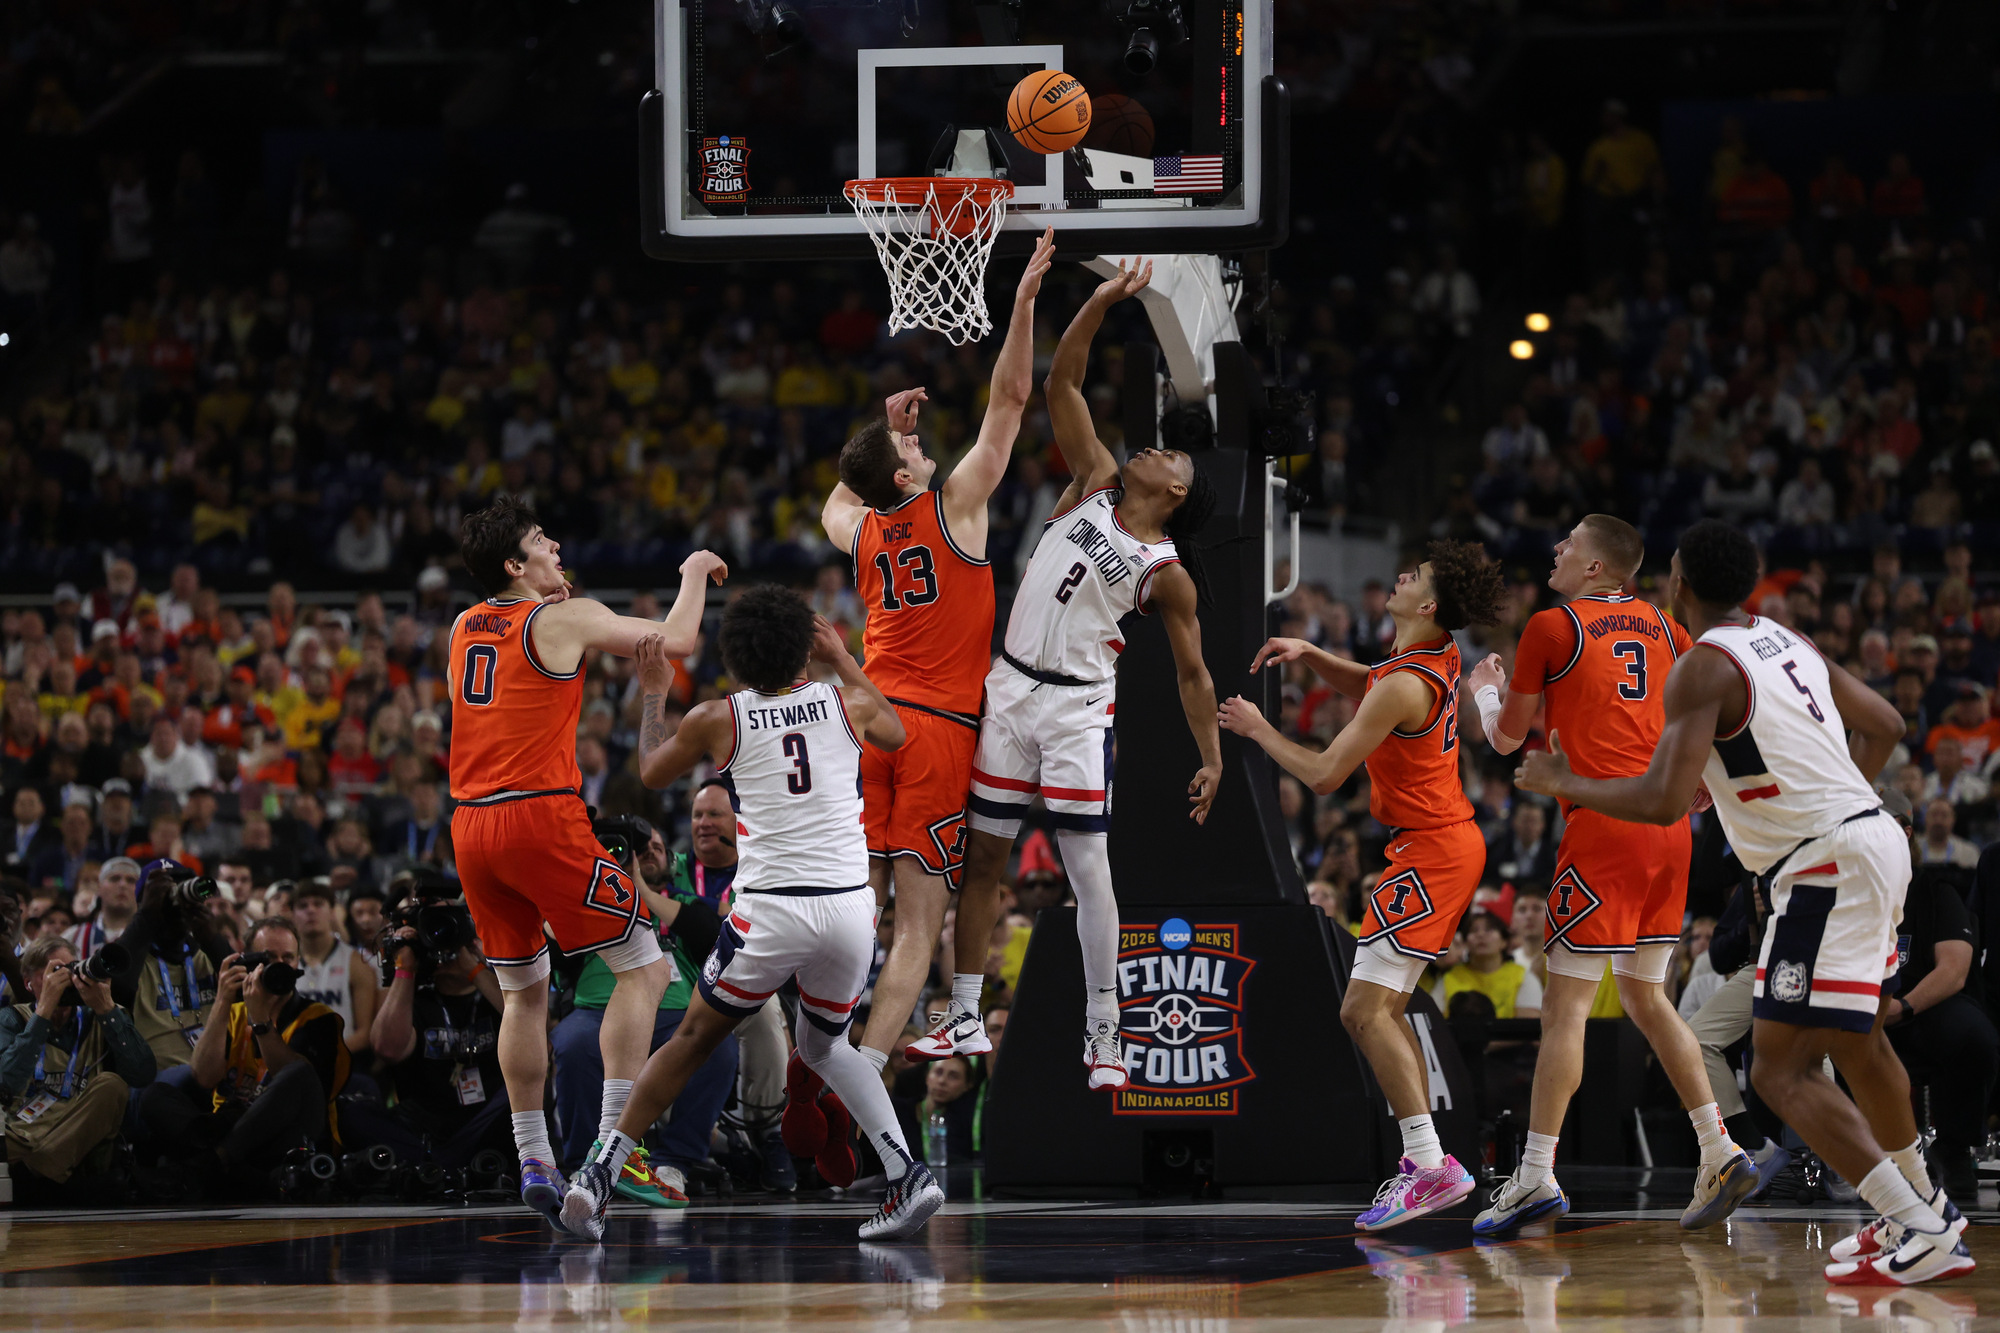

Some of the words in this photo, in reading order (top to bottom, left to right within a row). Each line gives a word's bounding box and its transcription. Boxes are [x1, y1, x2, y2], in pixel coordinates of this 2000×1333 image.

[705, 148, 743, 163] FINAL
[706, 178, 743, 192] FOUR
[874, 544, 940, 611] 13
[1055, 561, 1087, 605] 2
[465, 614, 512, 638] MIRKOVIC
[1585, 614, 1661, 640] HUMRICHOUS
[1749, 636, 1782, 661] REED
[462, 643, 498, 706] 0
[1612, 640, 1647, 701] 3
[1781, 659, 1825, 723] 5
[748, 700, 828, 730] STEWART
[782, 732, 812, 795] 3
[160, 858, 174, 869] LA
[1121, 932, 1155, 949] 2026
[1163, 933, 1191, 942] NCAA
[1196, 933, 1231, 948] MEN'S
[1117, 955, 1229, 997] FINAL
[1124, 1043, 1230, 1084] FOUR
[1122, 1091, 1229, 1108] INDIANAPOLIS
